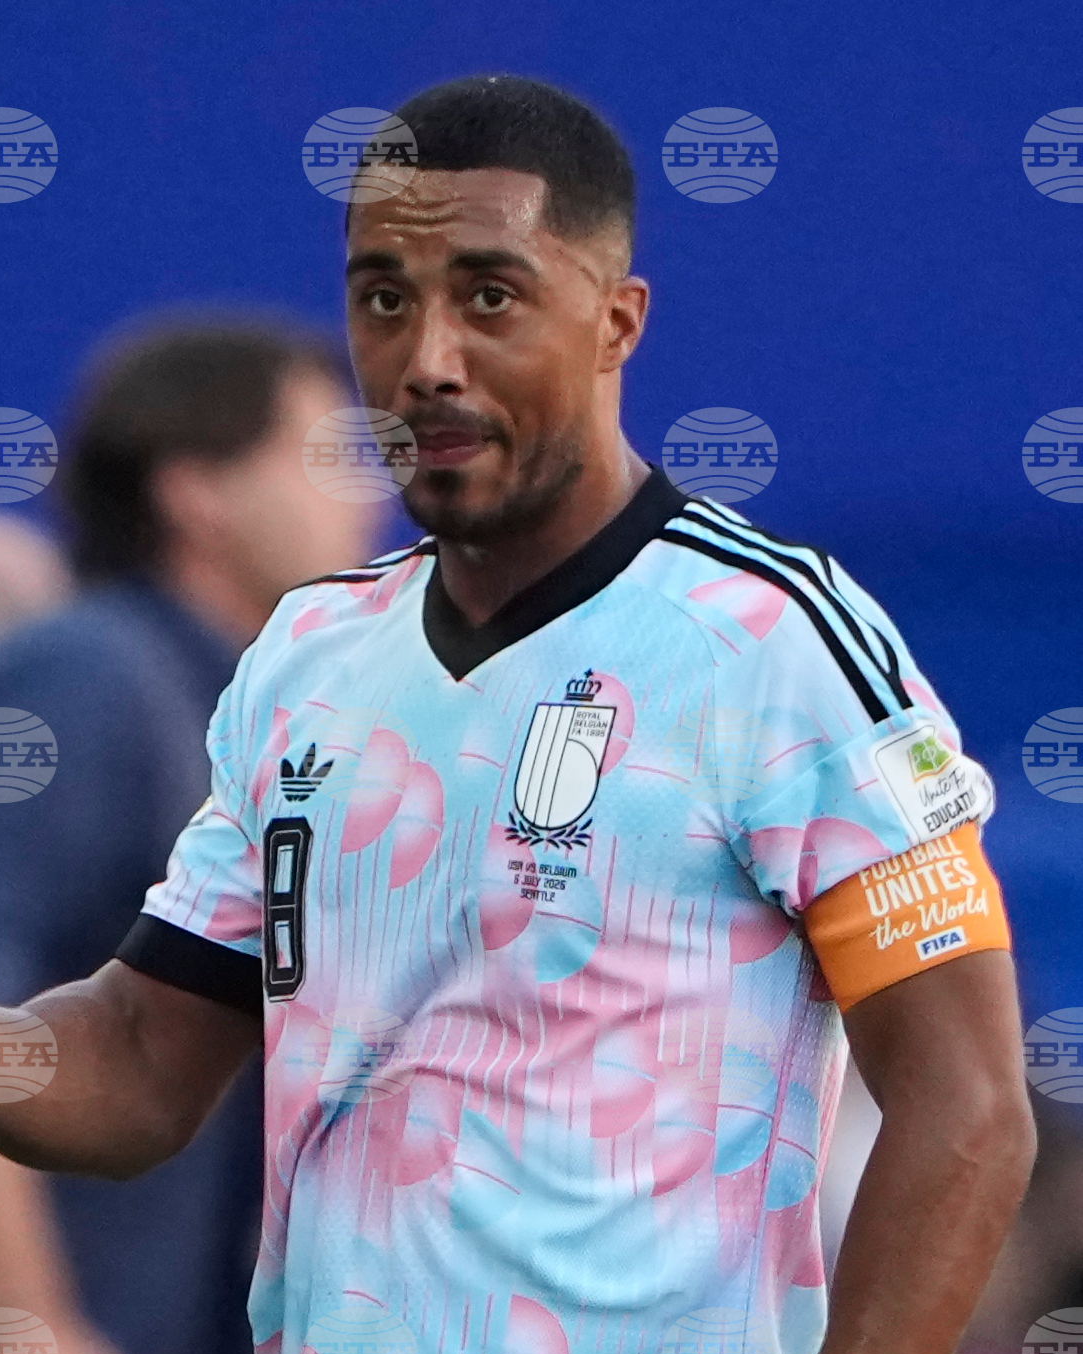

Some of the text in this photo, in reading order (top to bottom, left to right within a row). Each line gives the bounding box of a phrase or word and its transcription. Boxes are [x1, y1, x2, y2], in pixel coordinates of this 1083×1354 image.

[923, 788, 974, 833] EDUCATI
[521, 875, 541, 887] JULY
[539, 863, 577, 878] BELGIUM
[864, 857, 977, 917] UNITES
[263, 814, 313, 1002] 8
[520, 888, 555, 902] SEATTLE
[869, 887, 989, 950] the World
[921, 931, 962, 955] FIFA
